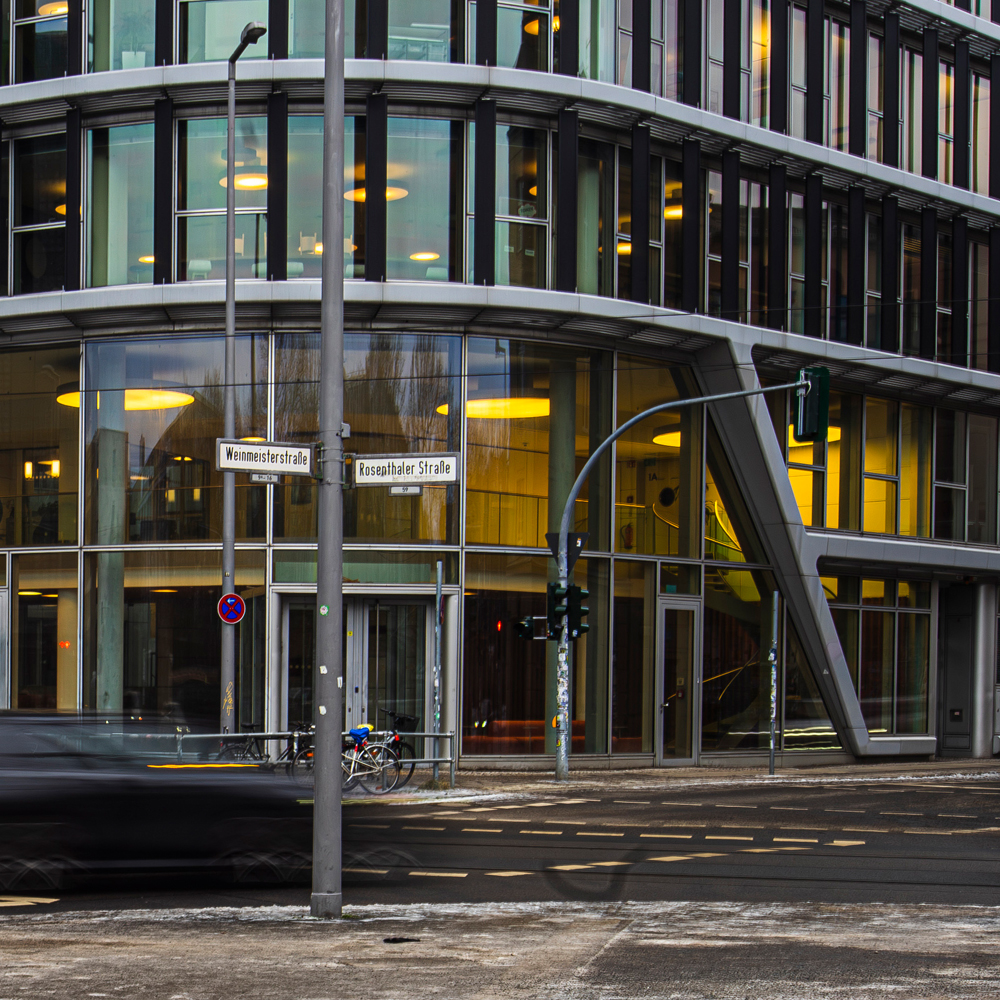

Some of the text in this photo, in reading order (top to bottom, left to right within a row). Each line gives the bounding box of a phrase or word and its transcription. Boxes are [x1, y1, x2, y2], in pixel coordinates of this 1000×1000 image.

[226, 447, 308, 466] Weinmeisterstraße
[359, 460, 451, 476] Rosenthaler Straße
